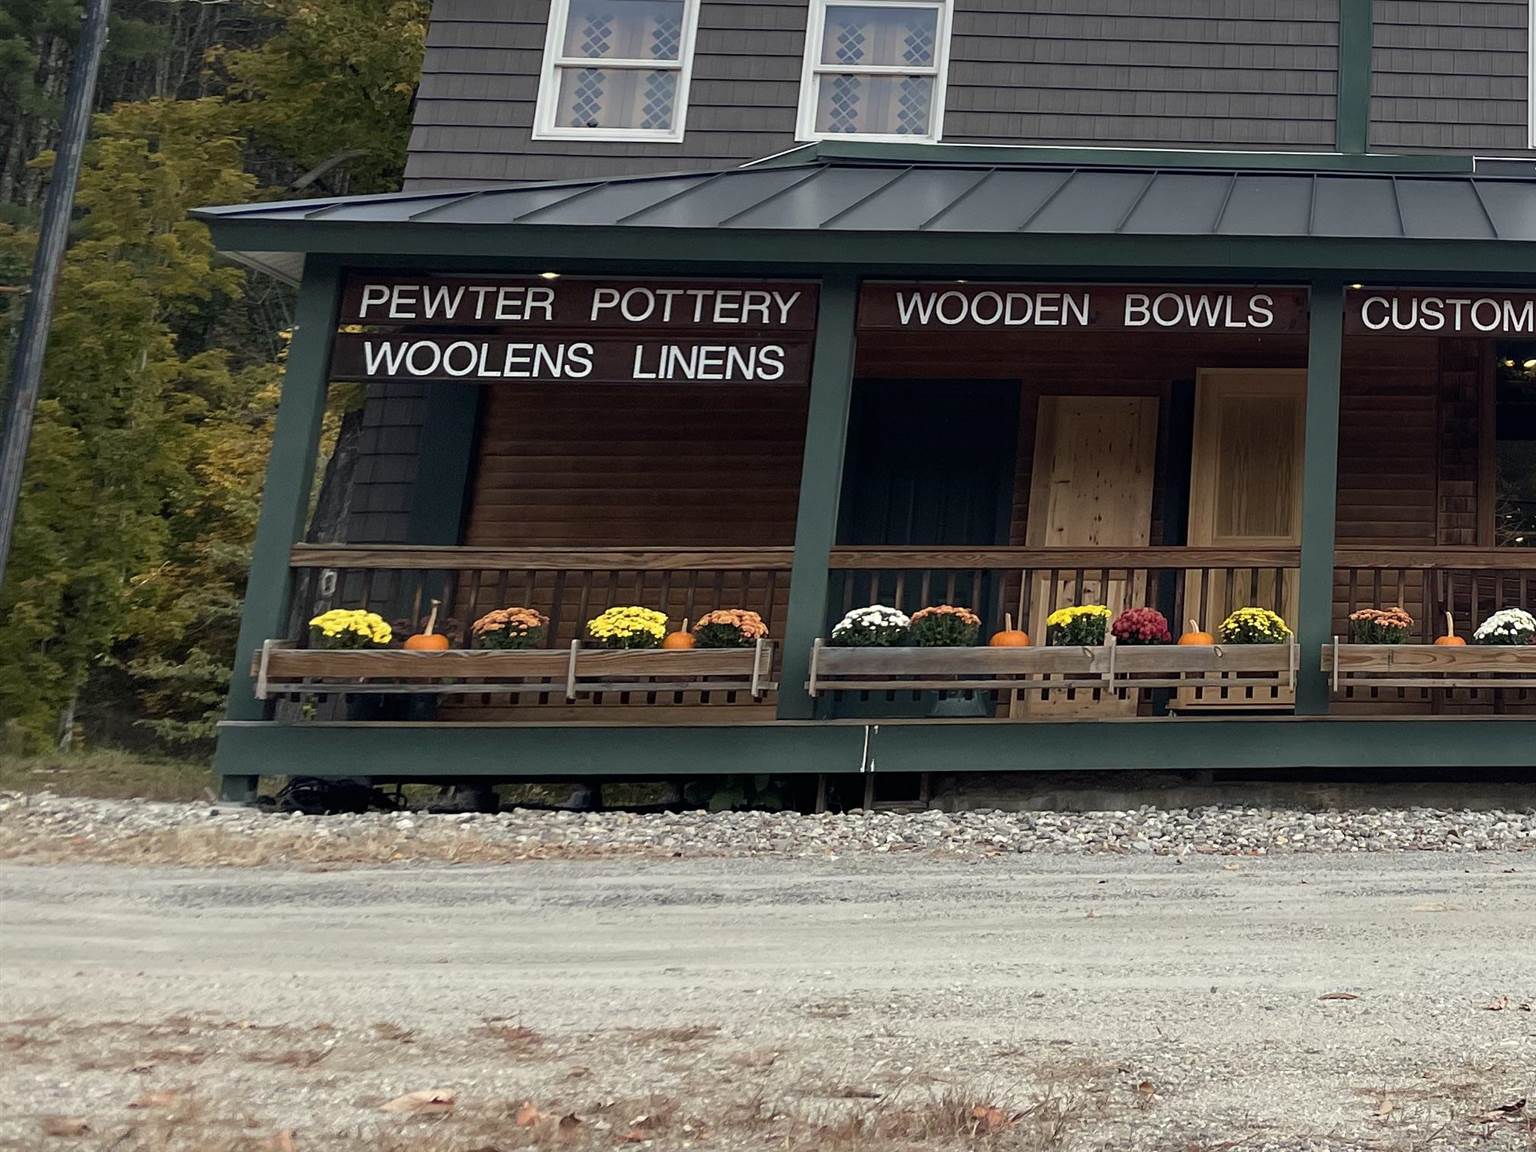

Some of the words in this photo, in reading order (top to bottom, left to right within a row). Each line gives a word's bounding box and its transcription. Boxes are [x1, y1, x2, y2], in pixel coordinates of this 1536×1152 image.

[359, 285, 555, 321] PEWTER
[590, 288, 801, 324] POTTERY
[897, 291, 1090, 326] WOODEN
[1124, 293, 1274, 328] BOWLS
[1361, 297, 1534, 332] CUSTOM
[364, 340, 594, 378] WOOLENS
[632, 344, 785, 380] LINENS
